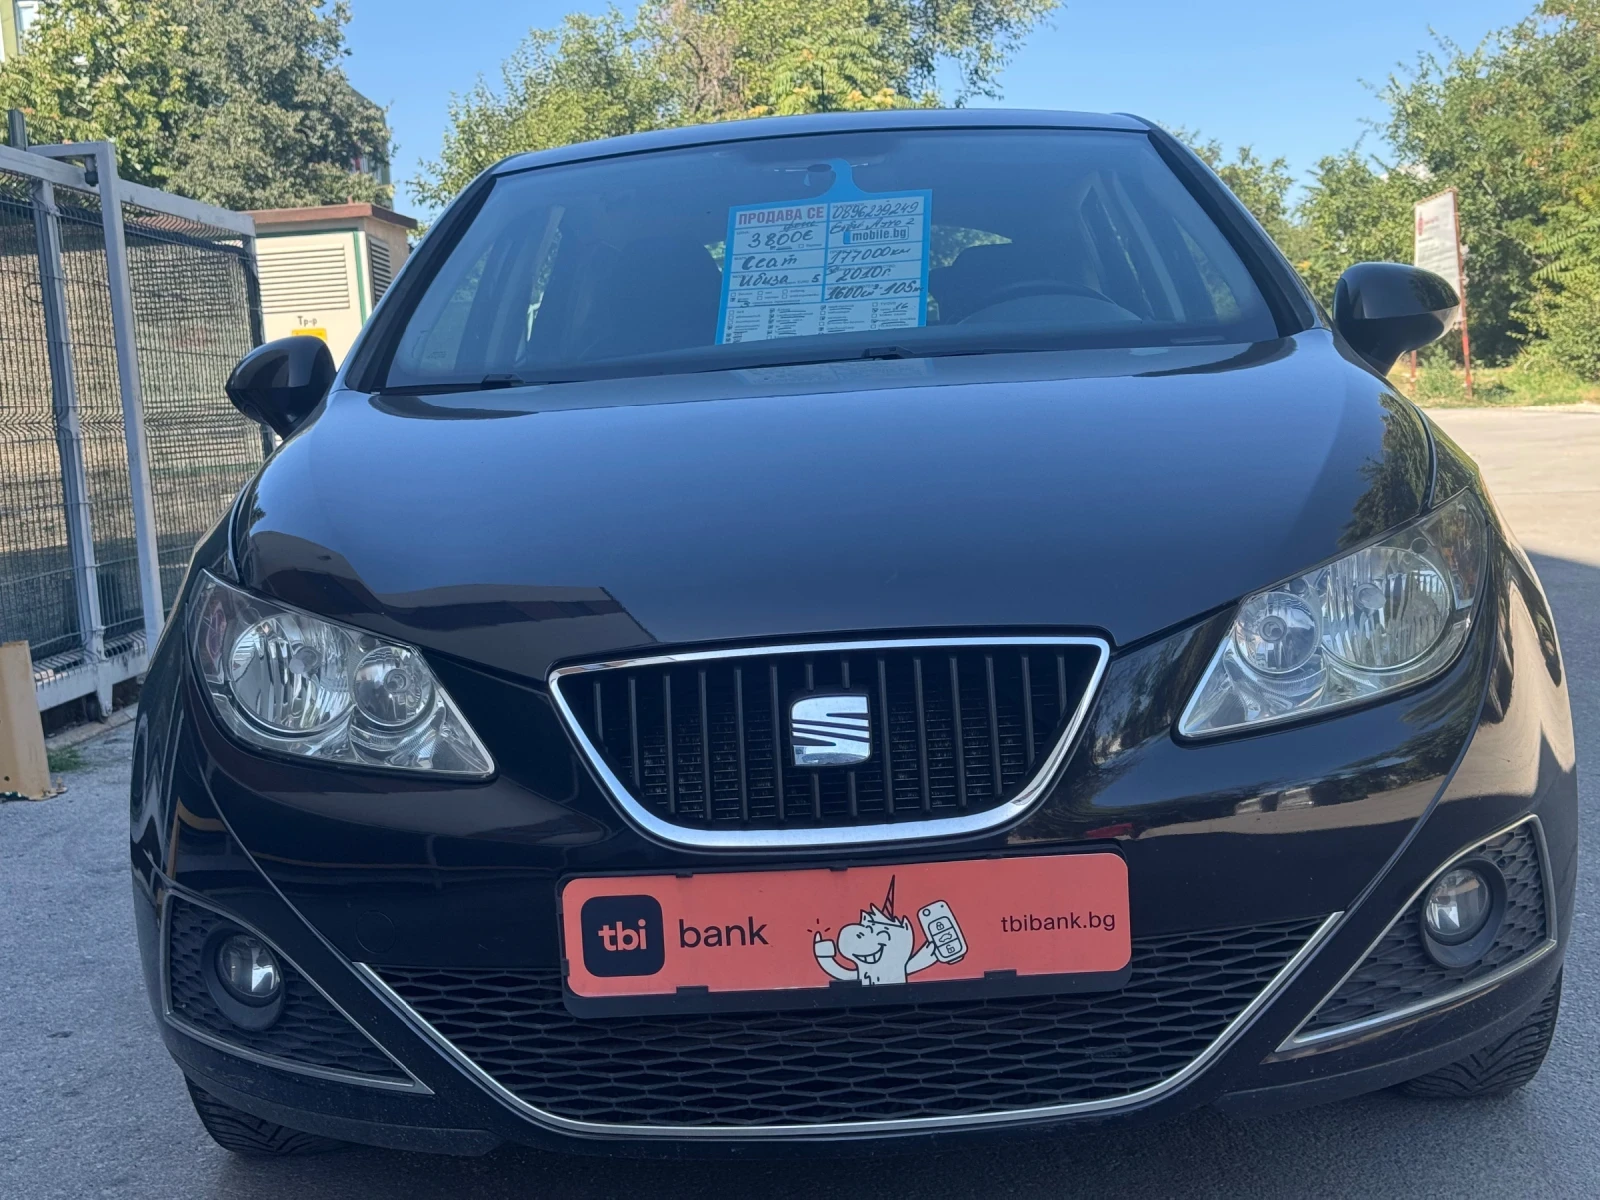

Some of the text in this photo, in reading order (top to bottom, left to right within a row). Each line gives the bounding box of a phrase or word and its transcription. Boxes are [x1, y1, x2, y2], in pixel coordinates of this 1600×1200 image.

[738, 206, 825, 225] ПРОДАВА СЕ
[852, 228, 907, 241] mobile.bg
[1000, 909, 1117, 935] tbibank.bg
[598, 916, 768, 952] tbi bank
